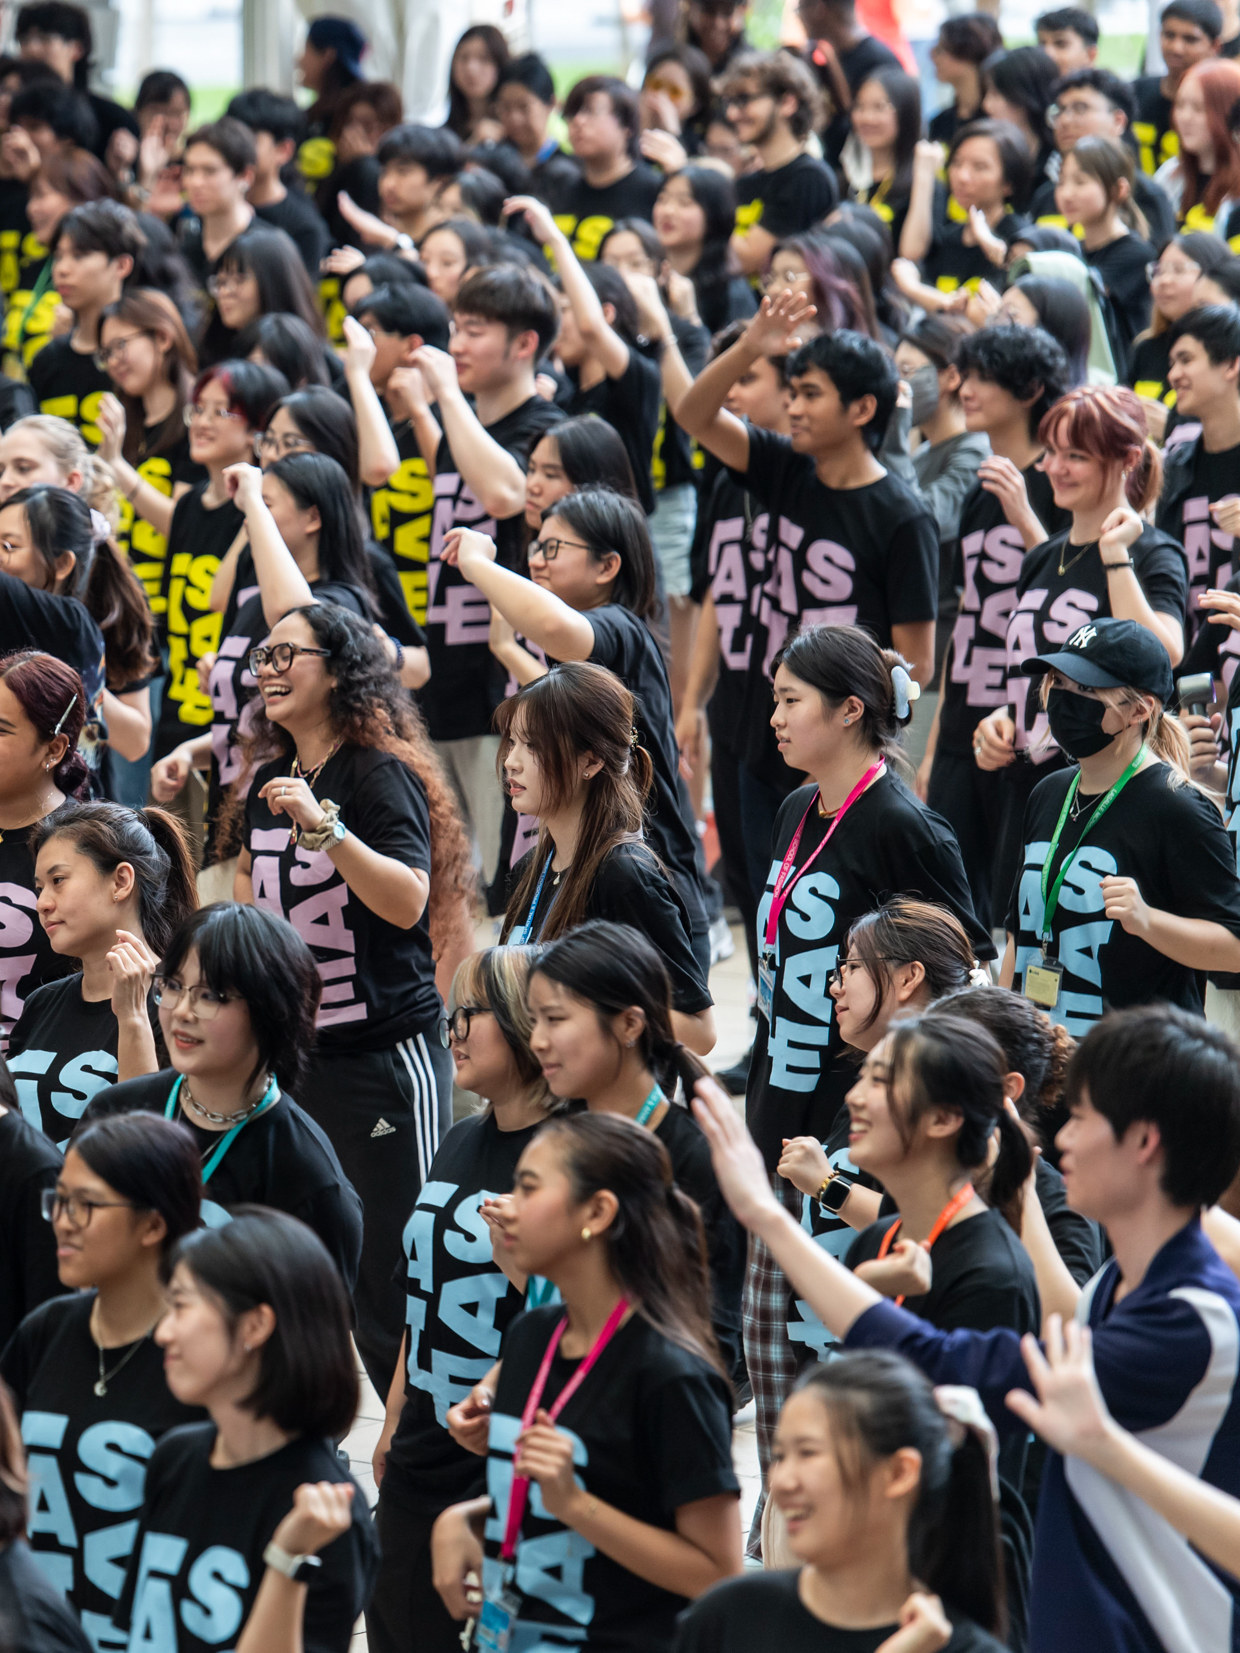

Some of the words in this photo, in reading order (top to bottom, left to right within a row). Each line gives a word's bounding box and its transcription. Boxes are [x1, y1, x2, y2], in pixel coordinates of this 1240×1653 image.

[783, 862, 790, 872] OF
[774, 871, 787, 898] FASHION
[370, 1124, 397, 1138] adidas
